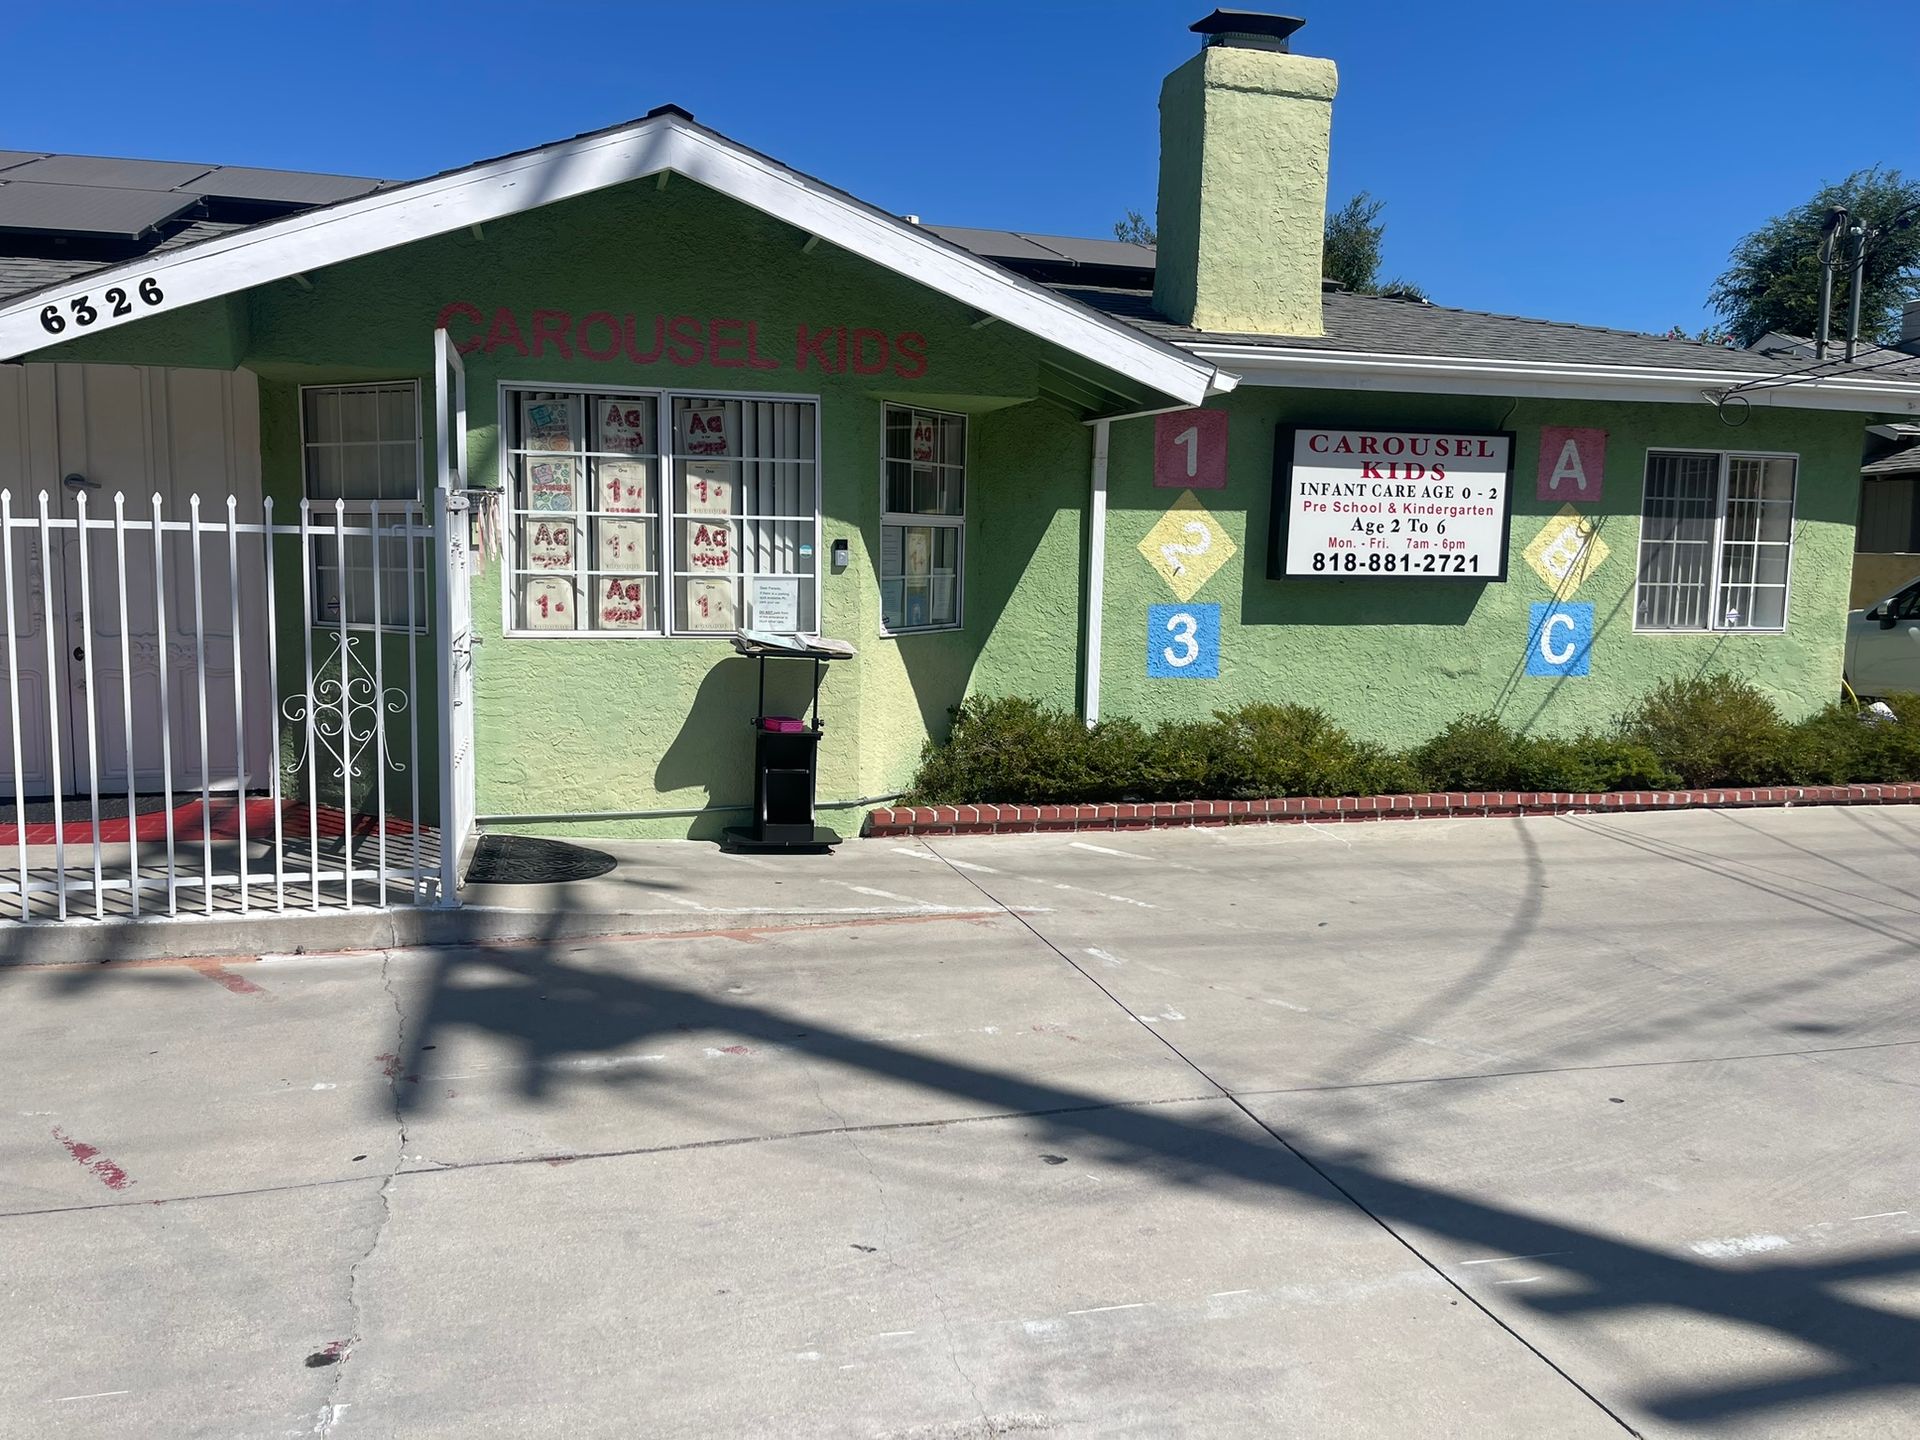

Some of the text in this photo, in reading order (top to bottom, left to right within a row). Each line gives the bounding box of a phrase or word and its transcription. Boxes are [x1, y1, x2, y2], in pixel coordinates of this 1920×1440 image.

[40, 277, 164, 334] 6326
[434, 301, 929, 380] CAROUSEL KIDS
[1174, 426, 1198, 477] 1
[1308, 434, 1495, 458] CAROUSEL
[1360, 460, 1446, 481] KIDS
[1549, 438, 1587, 491] A
[607, 477, 620, 503] 1
[694, 479, 708, 503] 1
[1299, 482, 1367, 497] INFANT
[1372, 483, 1416, 498] CARE
[1421, 485, 1454, 499] AGE
[1488, 487, 1498, 500] 2
[1303, 500, 1494, 518] Pre School & Kindergarten
[694, 524, 727, 547] Aa
[1350, 516, 1446, 536] Age 2 To 6
[606, 534, 620, 559] 1
[1159, 520, 1212, 576] 2
[1328, 537, 1357, 549] Mon.
[1369, 537, 1390, 549] Fri.
[1406, 538, 1430, 549] 7am
[1441, 538, 1466, 552] 6pm
[1540, 523, 1592, 580] B
[1312, 552, 1480, 573] 818-881-2721
[606, 578, 641, 601] Aa
[535, 594, 548, 618] 1
[695, 594, 708, 618] 1
[1163, 612, 1199, 668] 3
[1541, 613, 1575, 665] C
